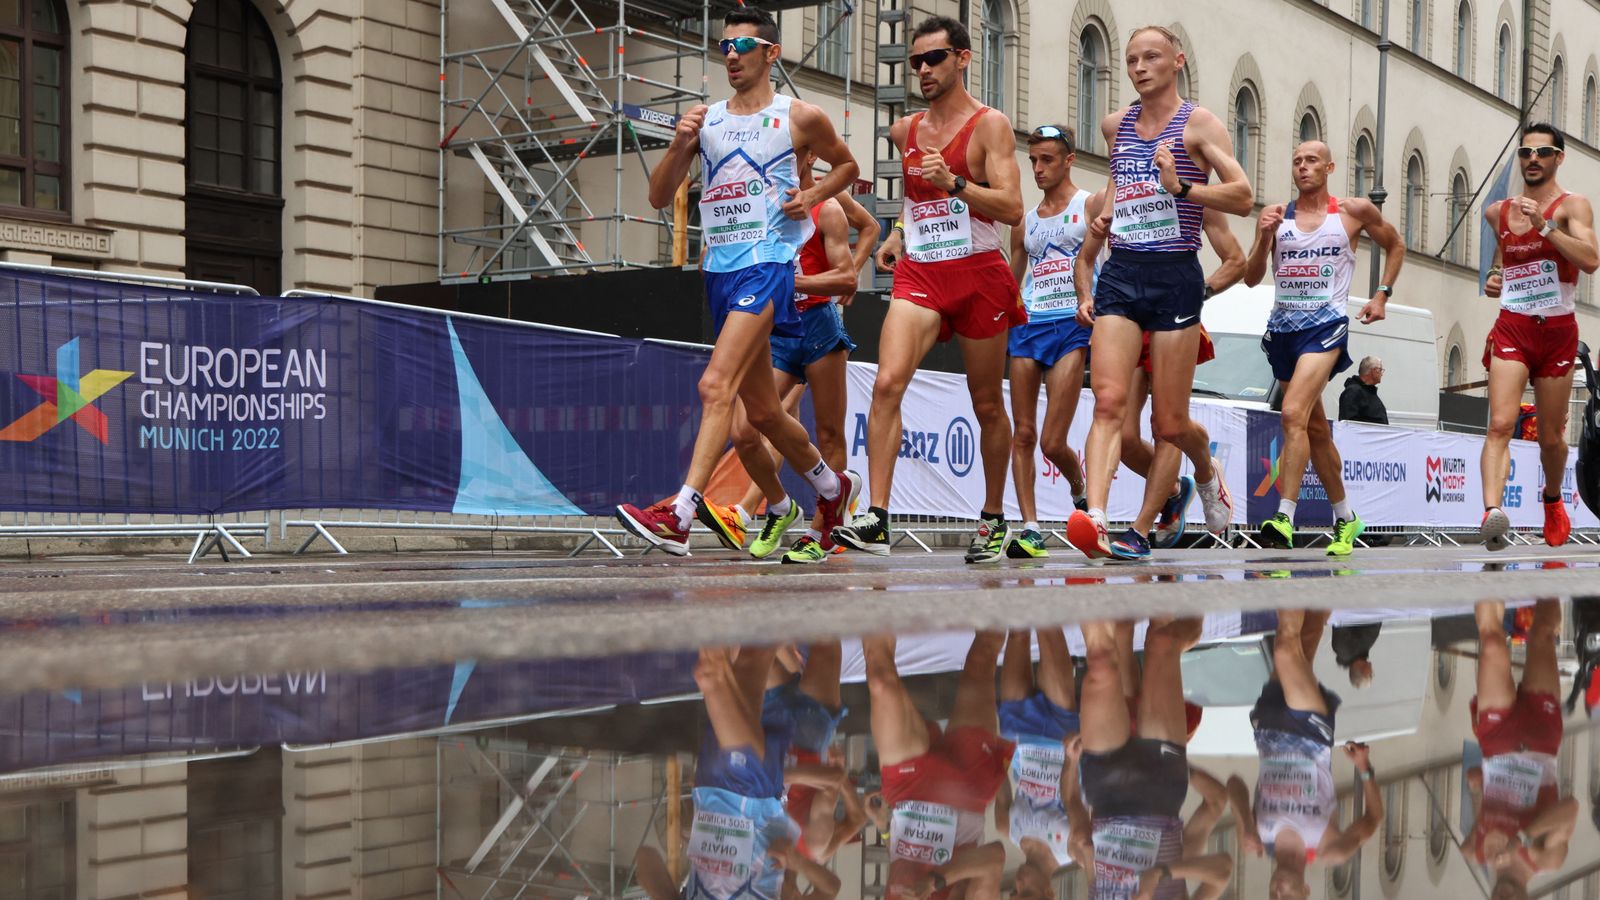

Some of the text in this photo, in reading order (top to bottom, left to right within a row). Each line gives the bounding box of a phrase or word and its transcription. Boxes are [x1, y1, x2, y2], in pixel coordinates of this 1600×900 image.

[722, 131, 760, 142] ITALIA
[1116, 160, 1160, 172] GREA
[702, 184, 746, 201] SPAR
[1116, 184, 1154, 201] SPAR
[714, 203, 751, 218] STANO
[913, 202, 948, 220] SPAR
[1115, 200, 1173, 219] WILKINSON
[727, 217, 738, 225] 46
[919, 219, 959, 236] MARTÍN
[1139, 216, 1147, 224] 27
[709, 230, 764, 245] MUNICH 2022
[932, 234, 941, 242] 17
[1037, 227, 1065, 241] ITALIA
[1153, 227, 1176, 239] 2022
[910, 247, 969, 261] MUNICH 2022
[1281, 247, 1341, 261] FRANCE
[1034, 260, 1070, 276] SPAR
[1278, 267, 1319, 276] SPAR
[1506, 264, 1540, 280] SPAR
[1034, 275, 1074, 290] FORTUNA
[1280, 281, 1328, 289] CAMPION
[1508, 277, 1554, 293] AMEZCUA
[1034, 300, 1063, 310] MUNICH
[1540, 298, 1559, 308] 2022
[140, 341, 326, 389] EUROPEAN
[140, 390, 326, 422] CHAMPIONSHIPS
[140, 425, 280, 451] MUNICH 2022
[852, 413, 939, 463] Aanz
[1443, 475, 1465, 490] MODYF
[1443, 492, 1466, 503] WORKWEAR
